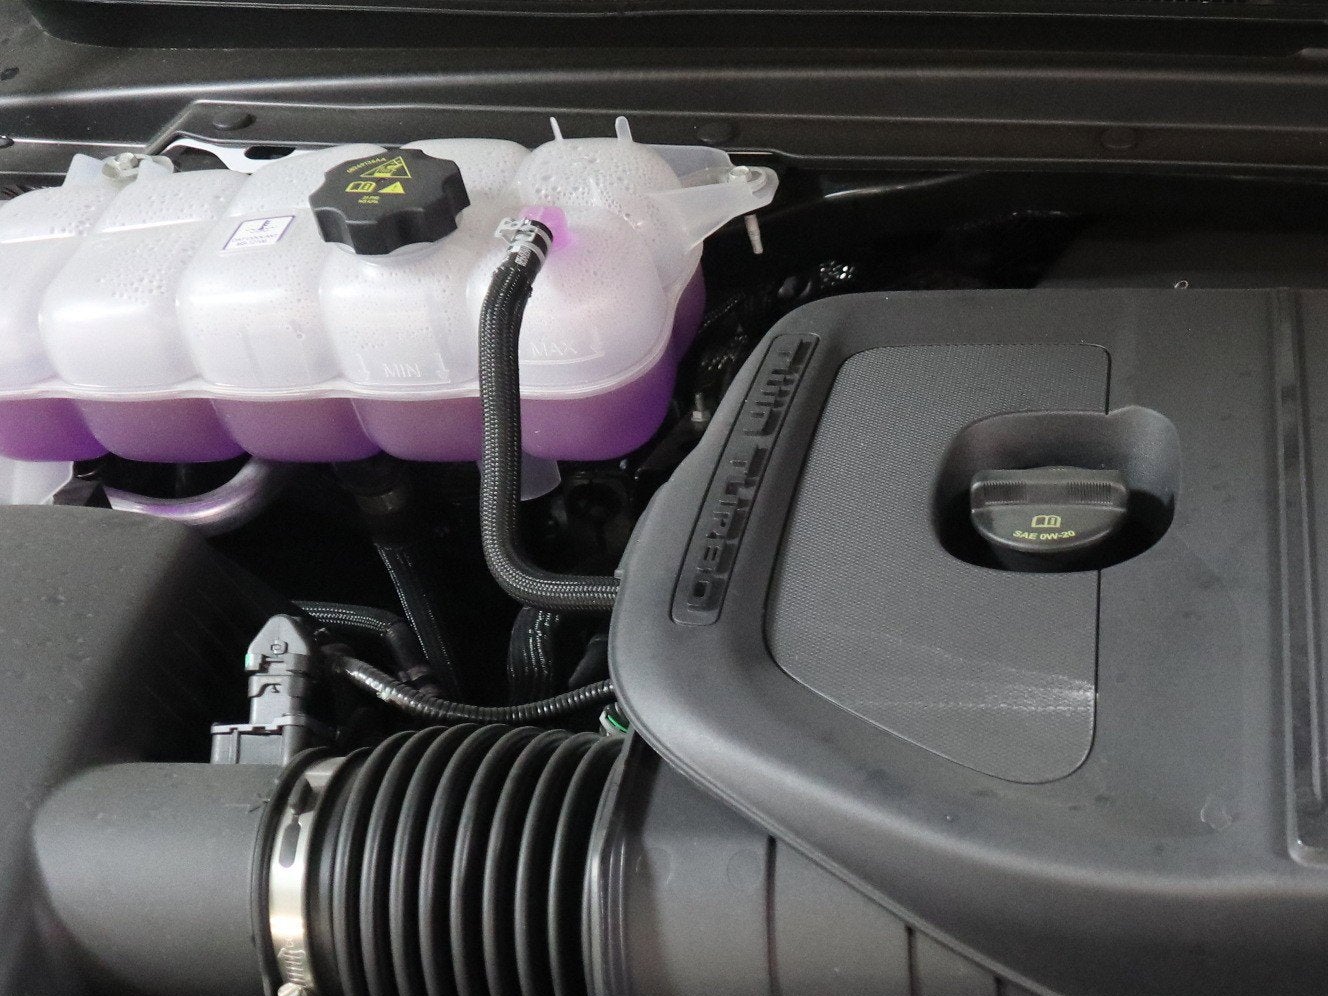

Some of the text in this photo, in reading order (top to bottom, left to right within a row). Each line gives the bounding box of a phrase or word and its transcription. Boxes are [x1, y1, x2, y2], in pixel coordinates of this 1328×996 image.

[384, 363, 423, 378] MIN
[686, 446, 769, 613] TURBO
[1013, 530, 1076, 540] SAE 0W-20
